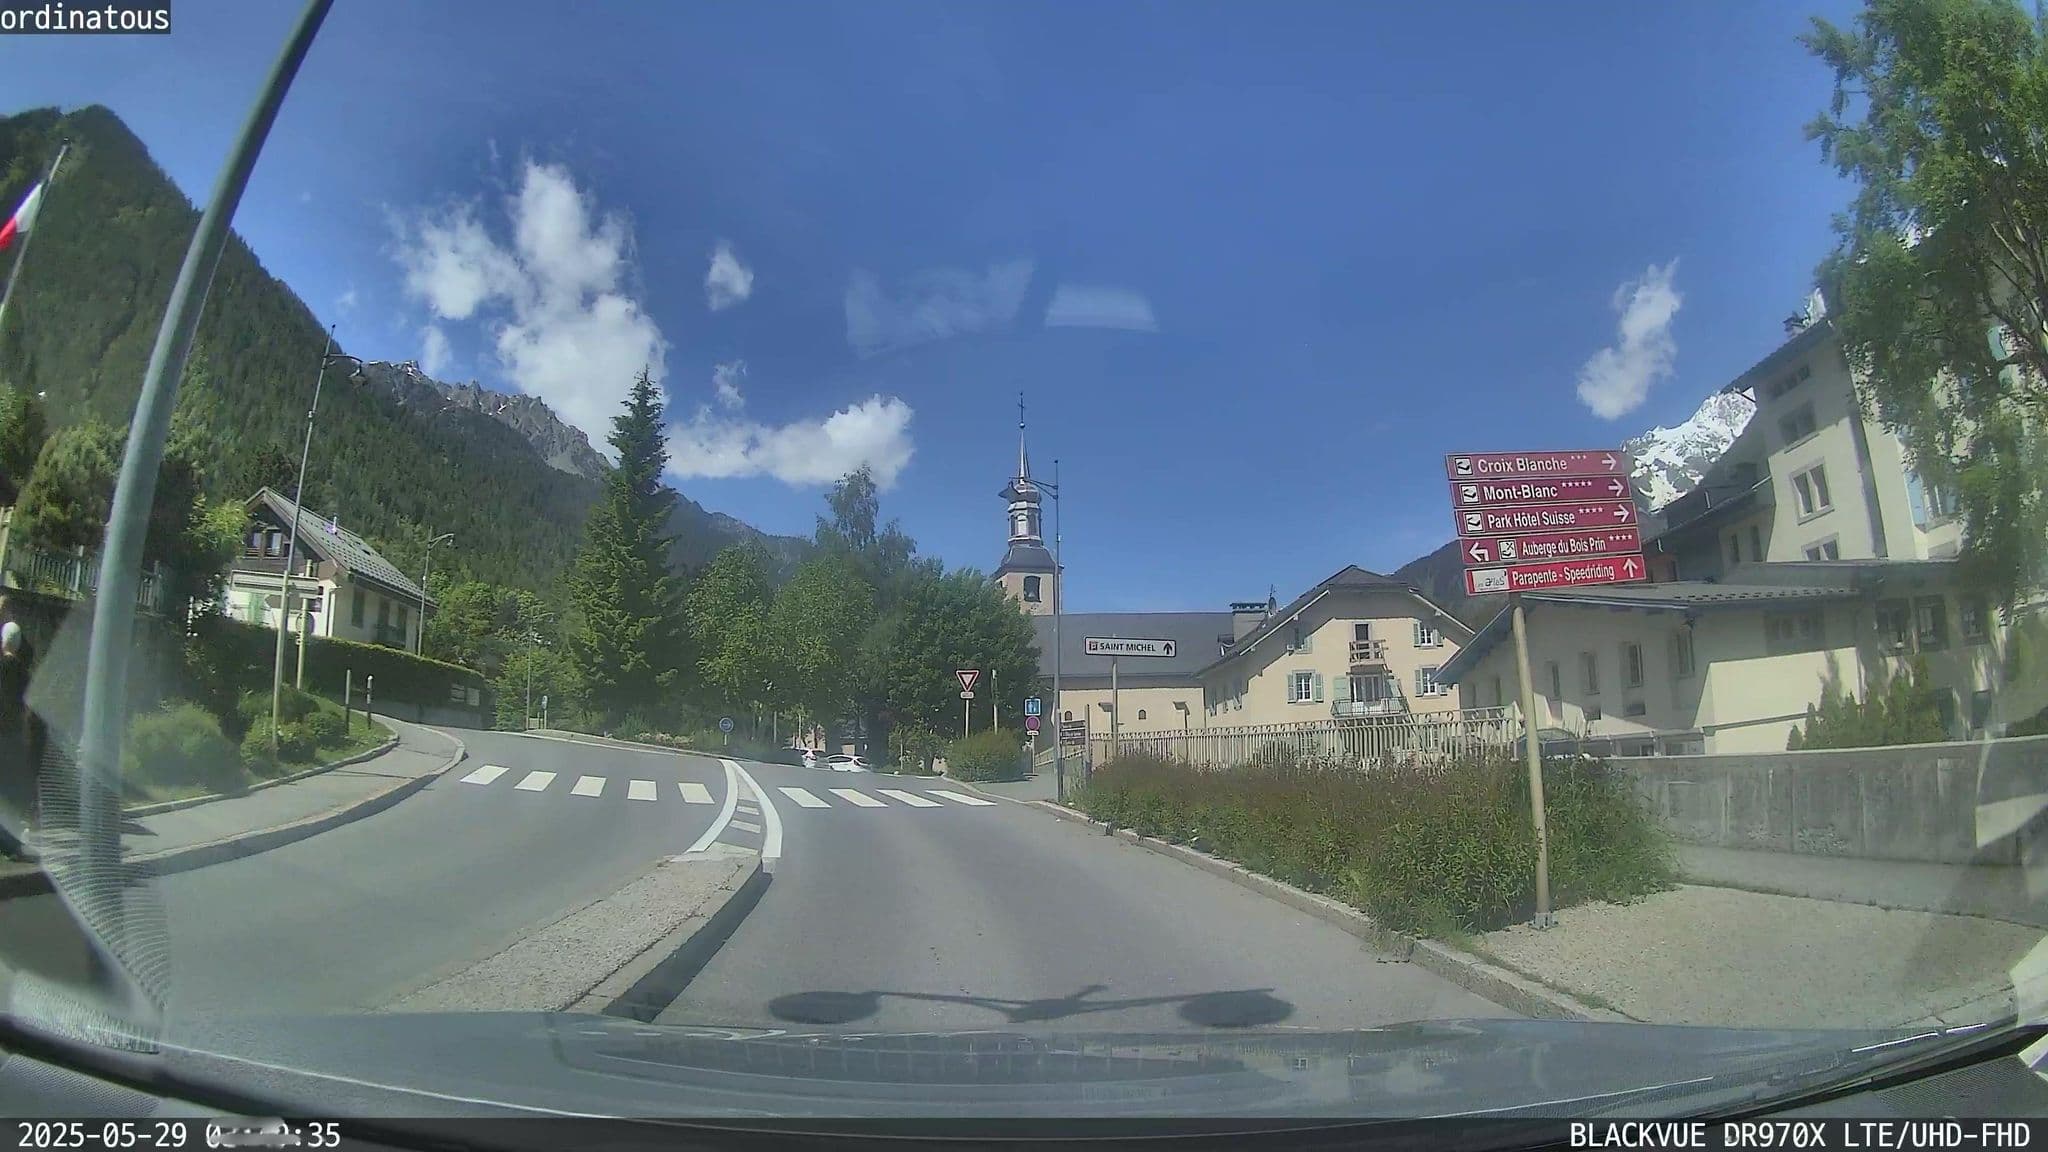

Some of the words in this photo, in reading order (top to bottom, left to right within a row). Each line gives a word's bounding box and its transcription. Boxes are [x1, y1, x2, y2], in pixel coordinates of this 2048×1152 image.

[1478, 458, 1513, 473] Croix
[1516, 457, 1568, 472] Blanche
[1483, 484, 1558, 501] Mont-Blanc
[1488, 513, 1512, 529] Park
[1514, 511, 1540, 527] Hôtel
[1542, 511, 1576, 526] Suisse
[1522, 541, 1557, 557] Auberge
[1558, 540, 1569, 553] du
[1570, 539, 1589, 553] Bois
[1590, 537, 1606, 551] Prin
[1512, 569, 1557, 588] Parapente
[1563, 564, 1616, 584] Speedriding
[1100, 642, 1124, 651] SAINT
[1126, 643, 1156, 652] MICHEL
